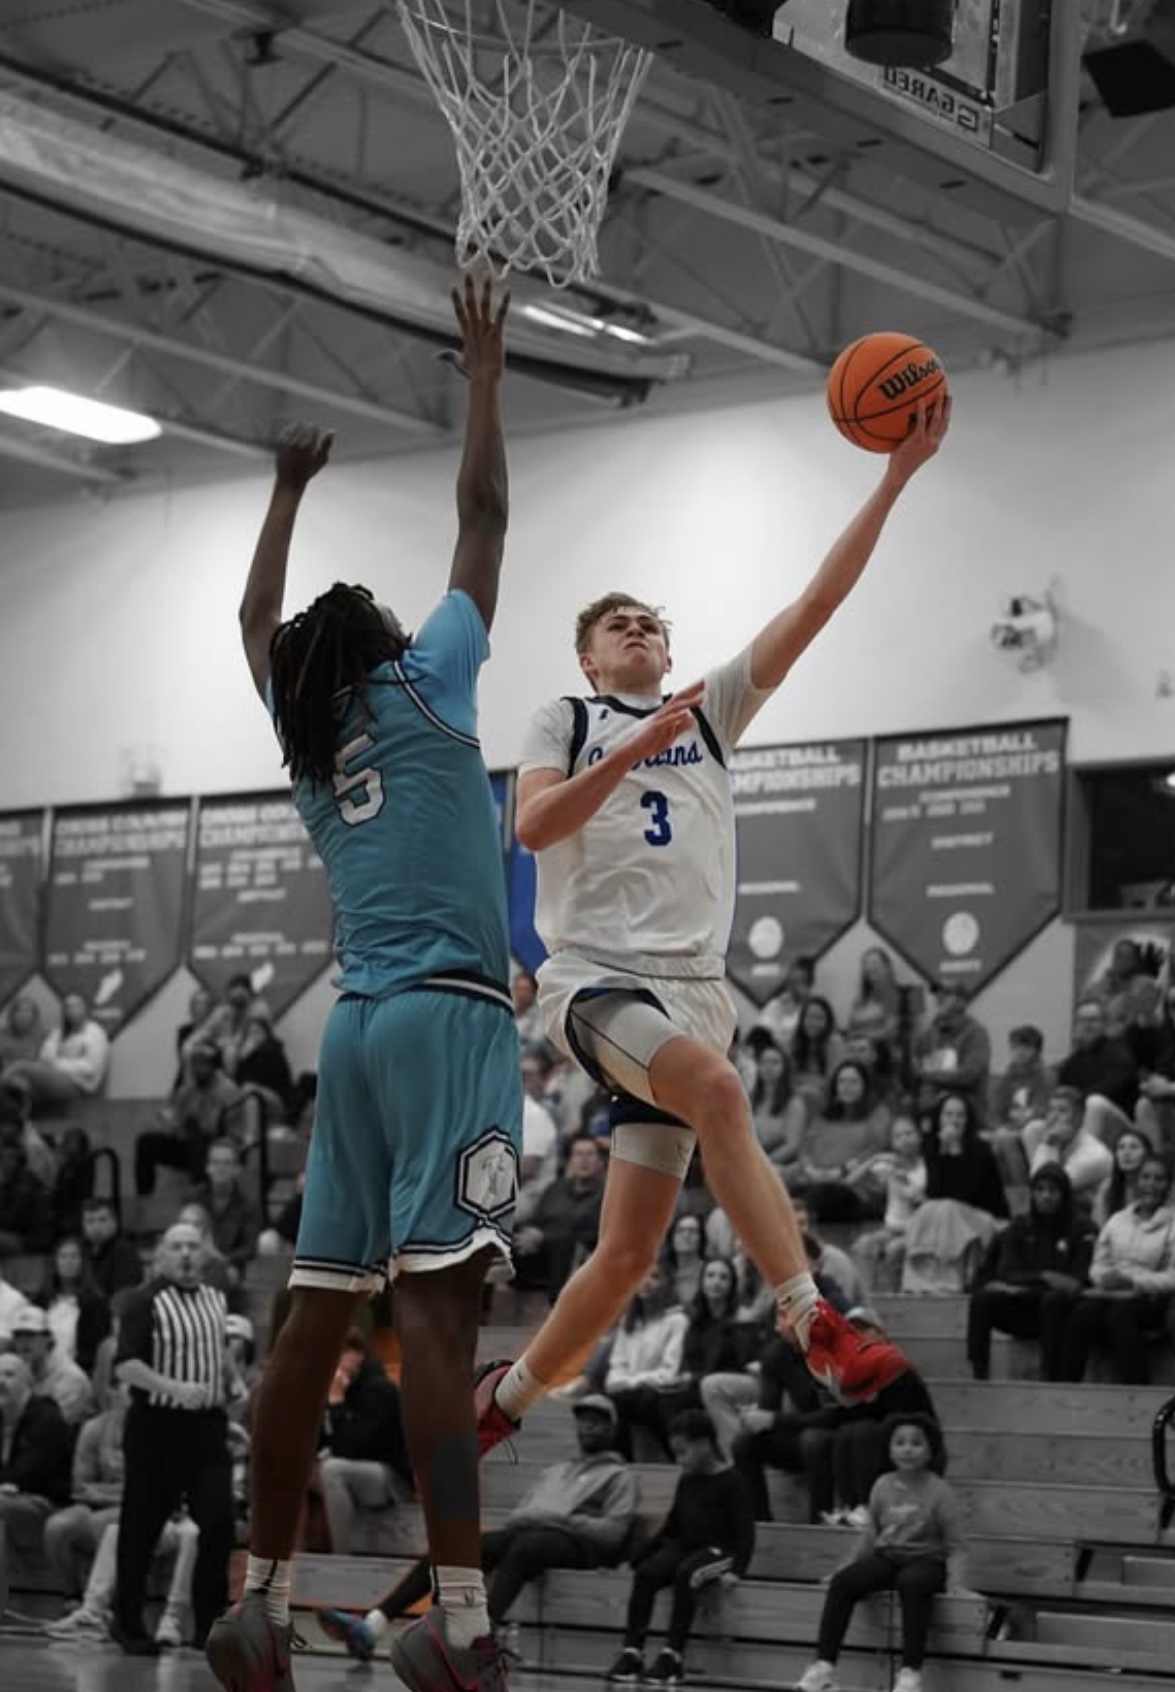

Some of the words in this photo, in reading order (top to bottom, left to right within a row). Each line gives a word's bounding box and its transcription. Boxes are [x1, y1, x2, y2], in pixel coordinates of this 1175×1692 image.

[332, 731, 384, 827] 5
[877, 750, 1060, 788] CHAMPIONSHIPS
[640, 790, 672, 846] 3
